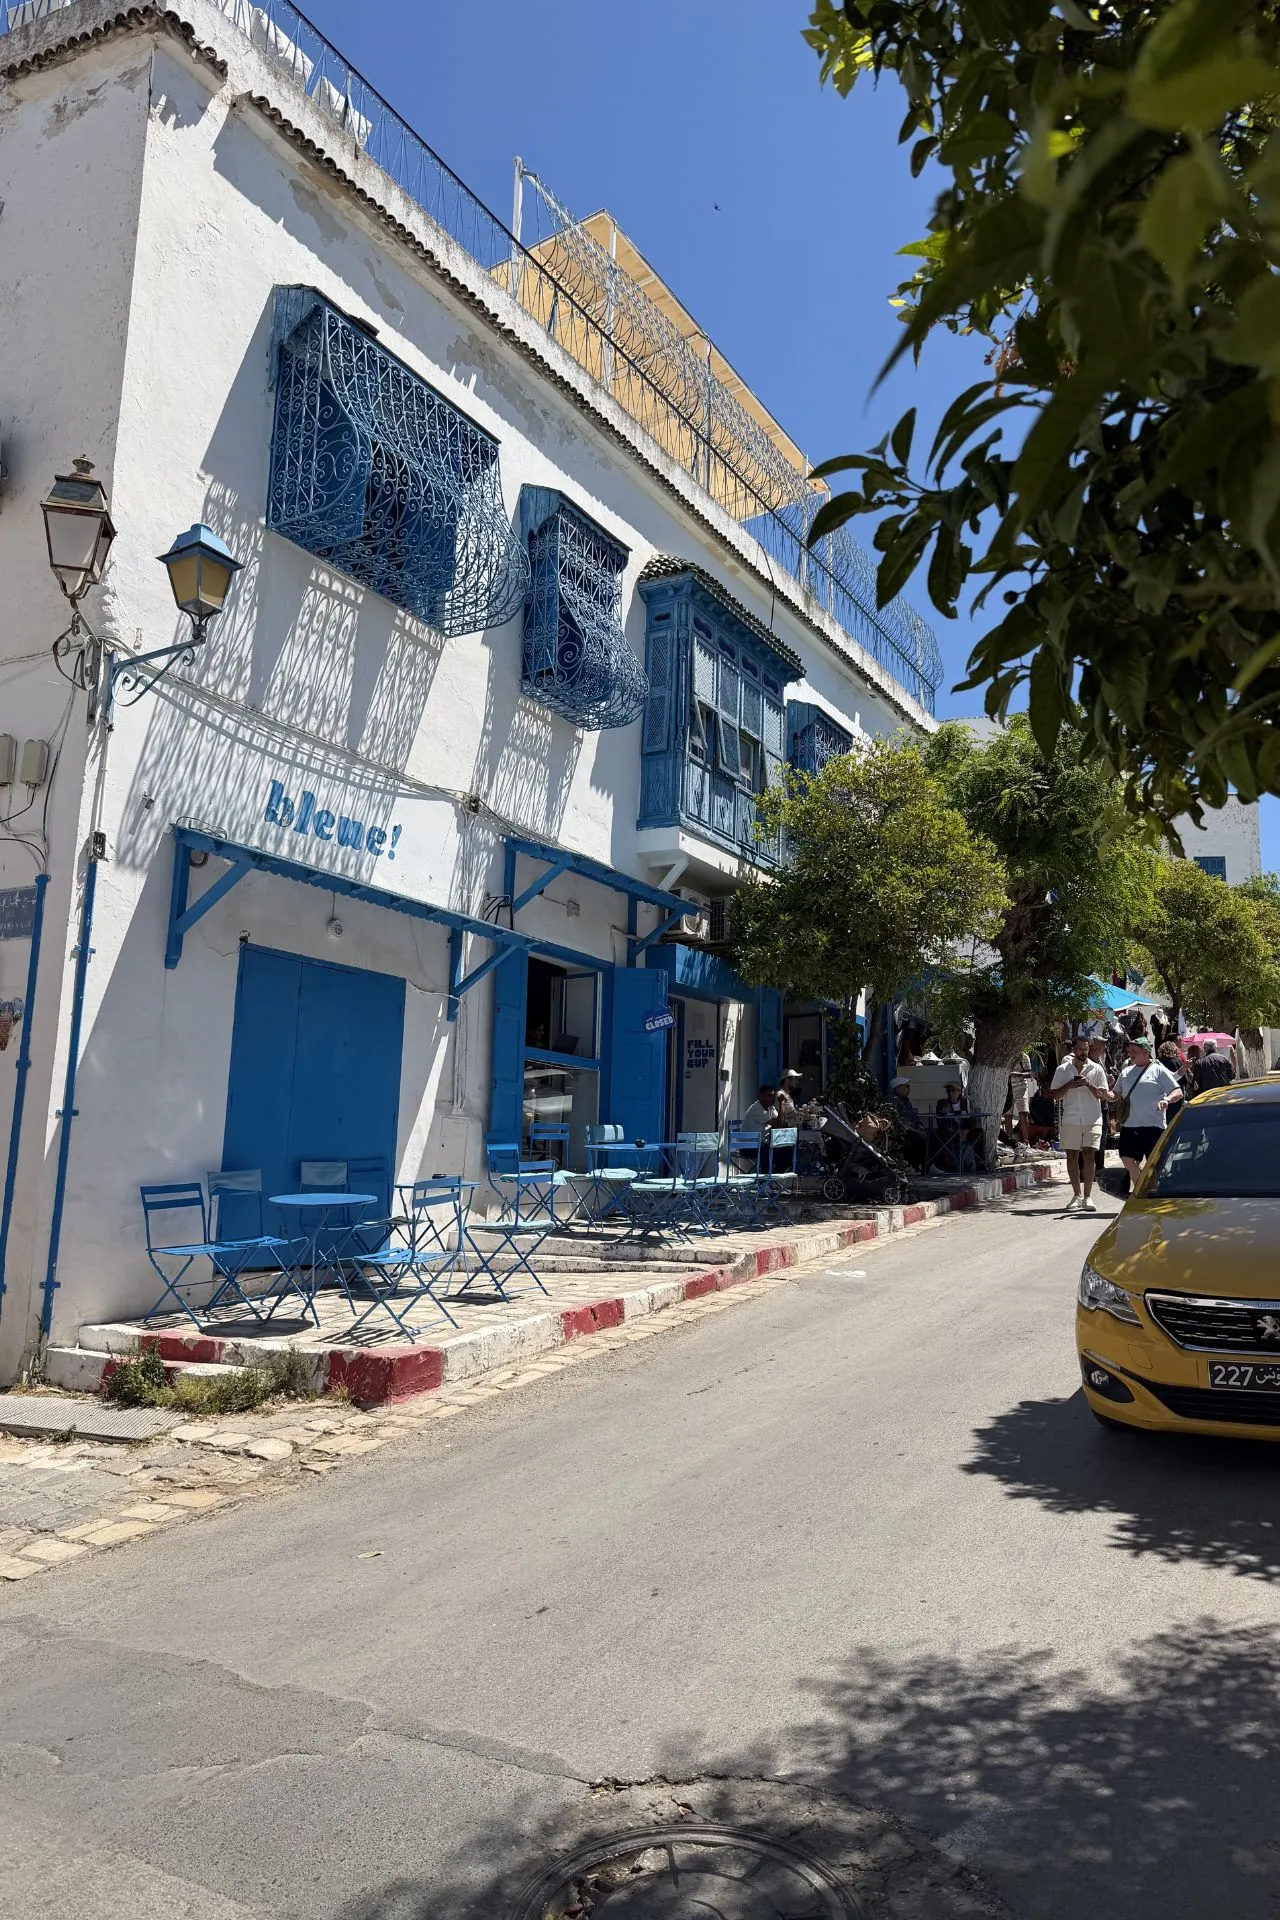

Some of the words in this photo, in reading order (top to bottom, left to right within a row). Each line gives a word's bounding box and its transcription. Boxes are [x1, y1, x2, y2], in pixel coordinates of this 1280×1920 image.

[264, 779, 402, 861] bleue!
[645, 1016, 674, 1031] CLOSED
[687, 1040, 713, 1049] FILL
[688, 1049, 715, 1058] YOUR
[687, 1058, 709, 1068] CUP
[1213, 1365, 1254, 1386] 227
